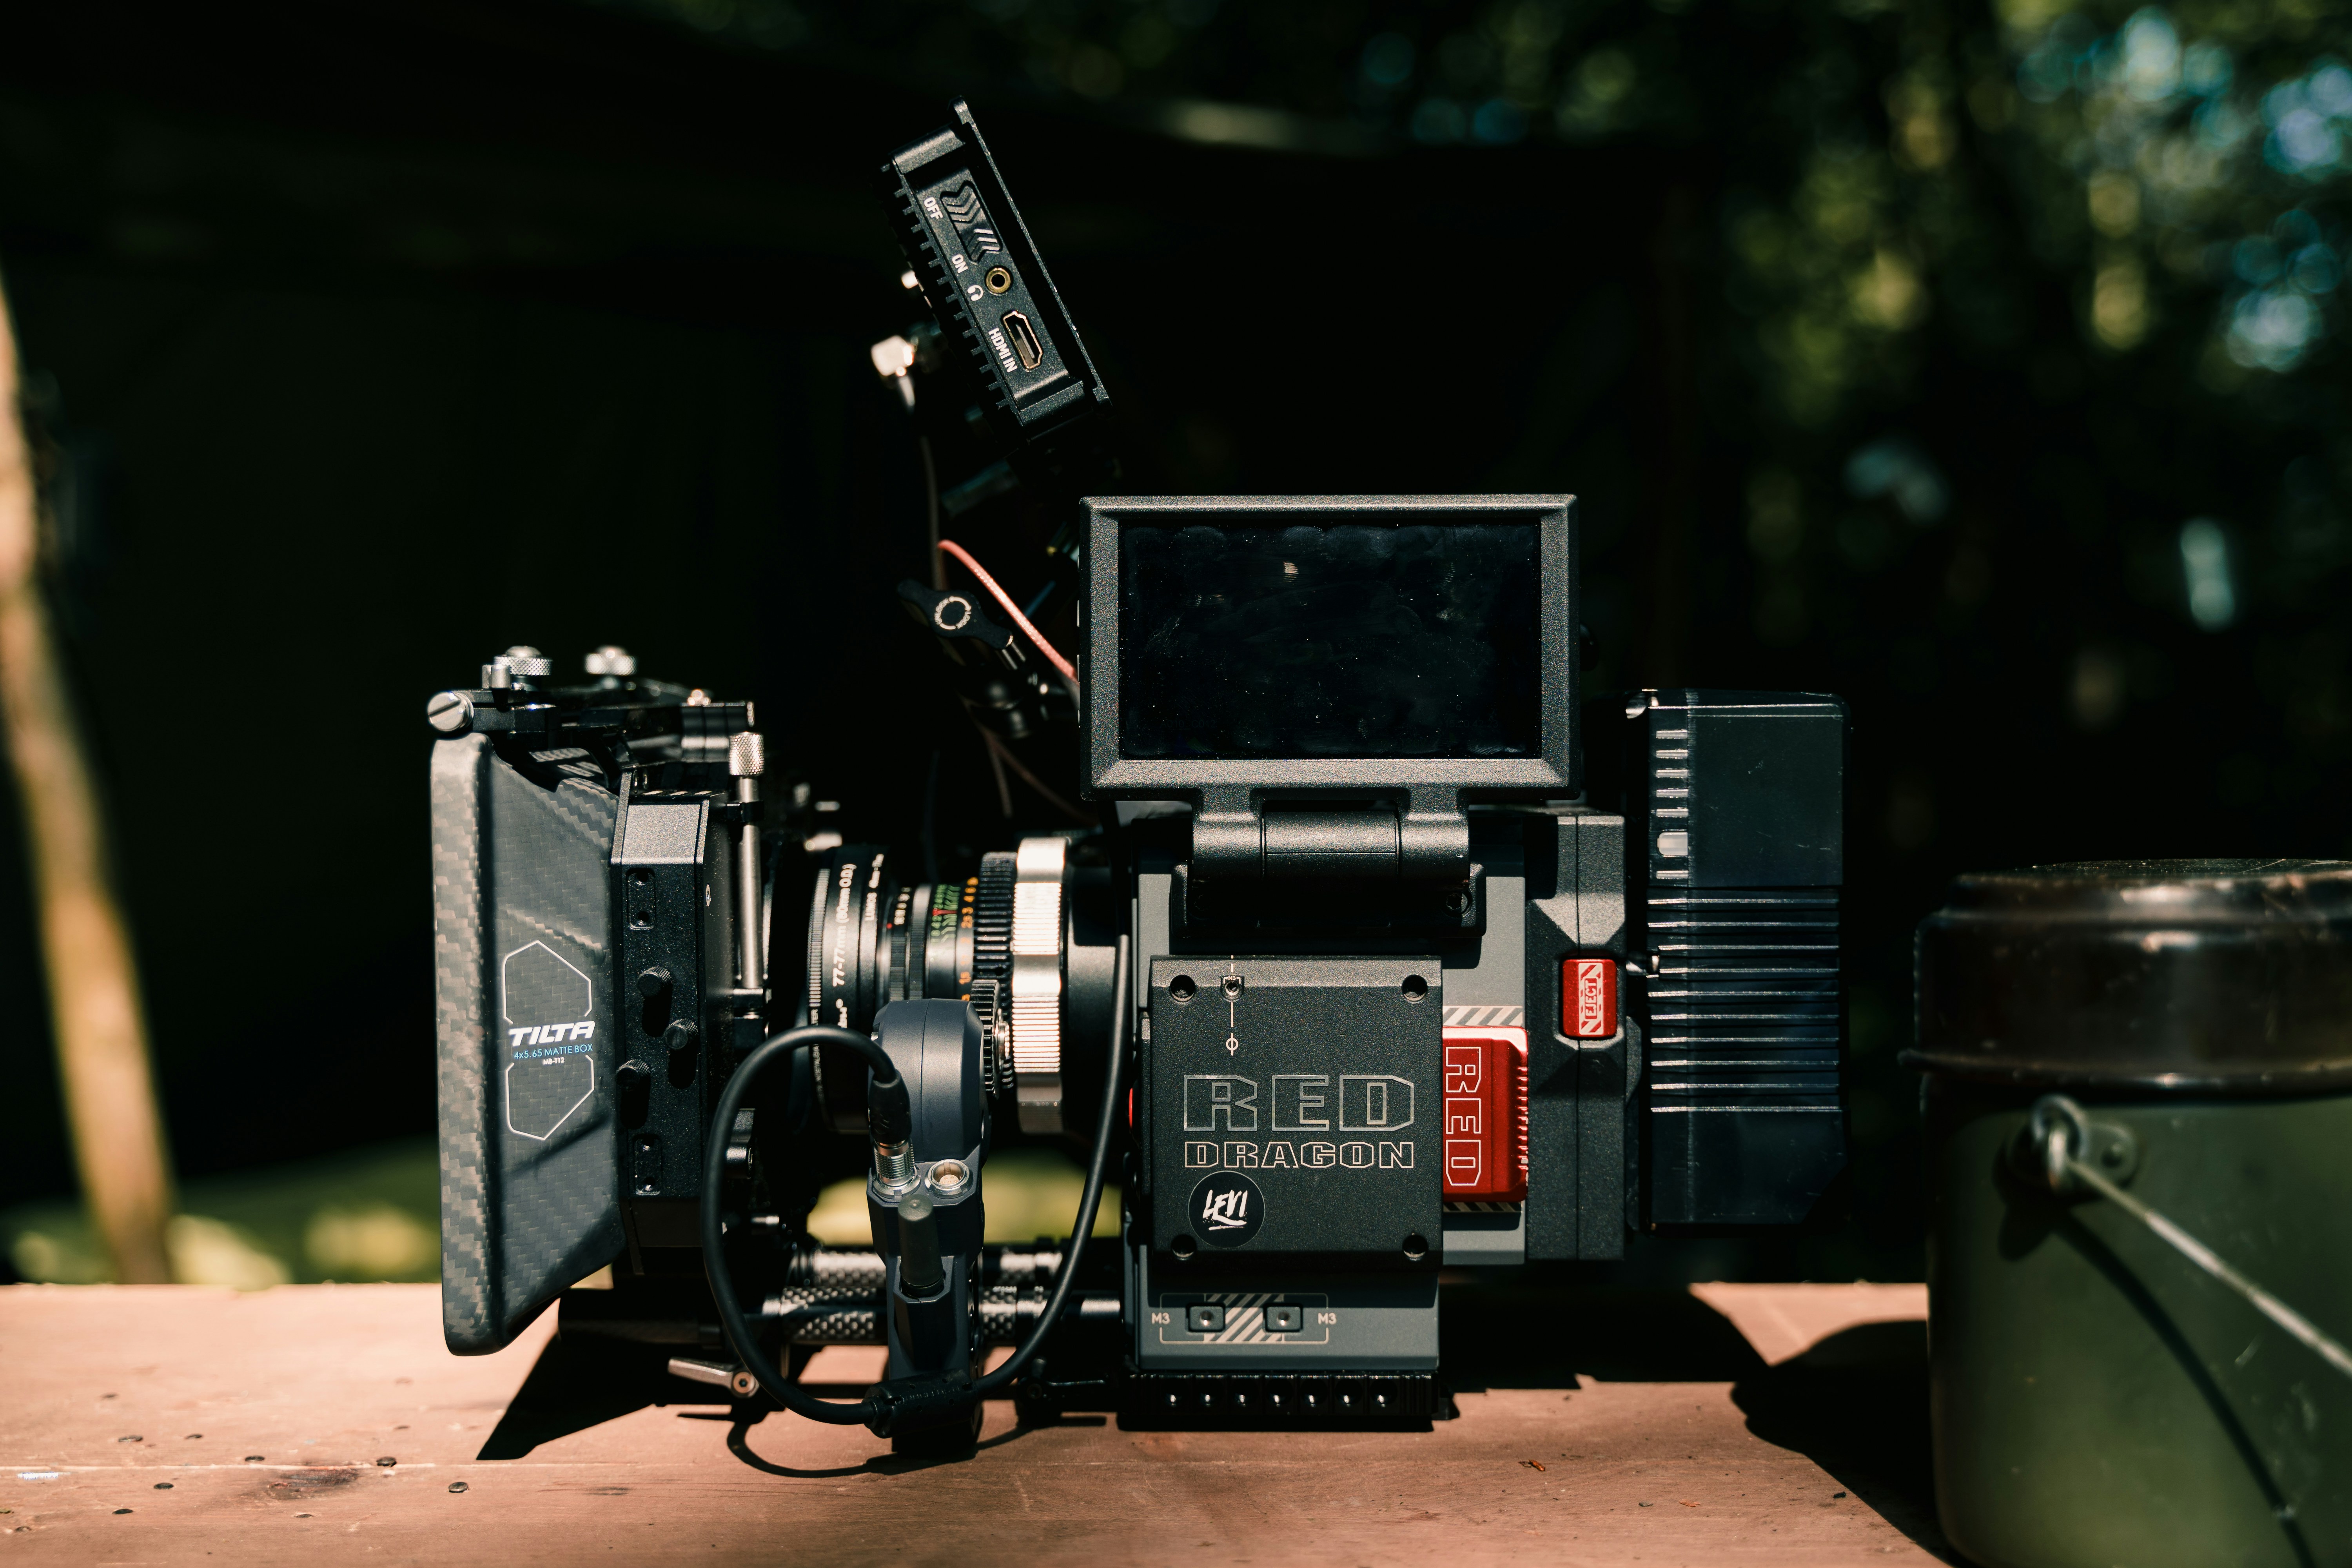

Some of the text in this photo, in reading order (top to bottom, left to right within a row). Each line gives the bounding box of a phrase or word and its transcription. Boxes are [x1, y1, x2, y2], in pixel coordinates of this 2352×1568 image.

[924, 197, 943, 220] OFF
[952, 254, 968, 274] ON
[988, 328, 1018, 373] HDMI IN
[955, 611, 972, 629] LOCK
[865, 892, 877, 921] LUMOS
[833, 926, 847, 987] 77-77mm
[1585, 980, 1597, 1016] EJECT
[508, 1021, 595, 1047] TILTA
[514, 1043, 593, 1059] 4x5.65 MATTE BOX
[543, 1057, 565, 1065] MB-T12
[1183, 1074, 1415, 1132] RED
[1445, 1046, 1481, 1186] RED
[1185, 1142, 1414, 1169] DRAGON
[1203, 1189, 1248, 1226] LEVI
[1151, 1312, 1337, 1325] M3 M3
